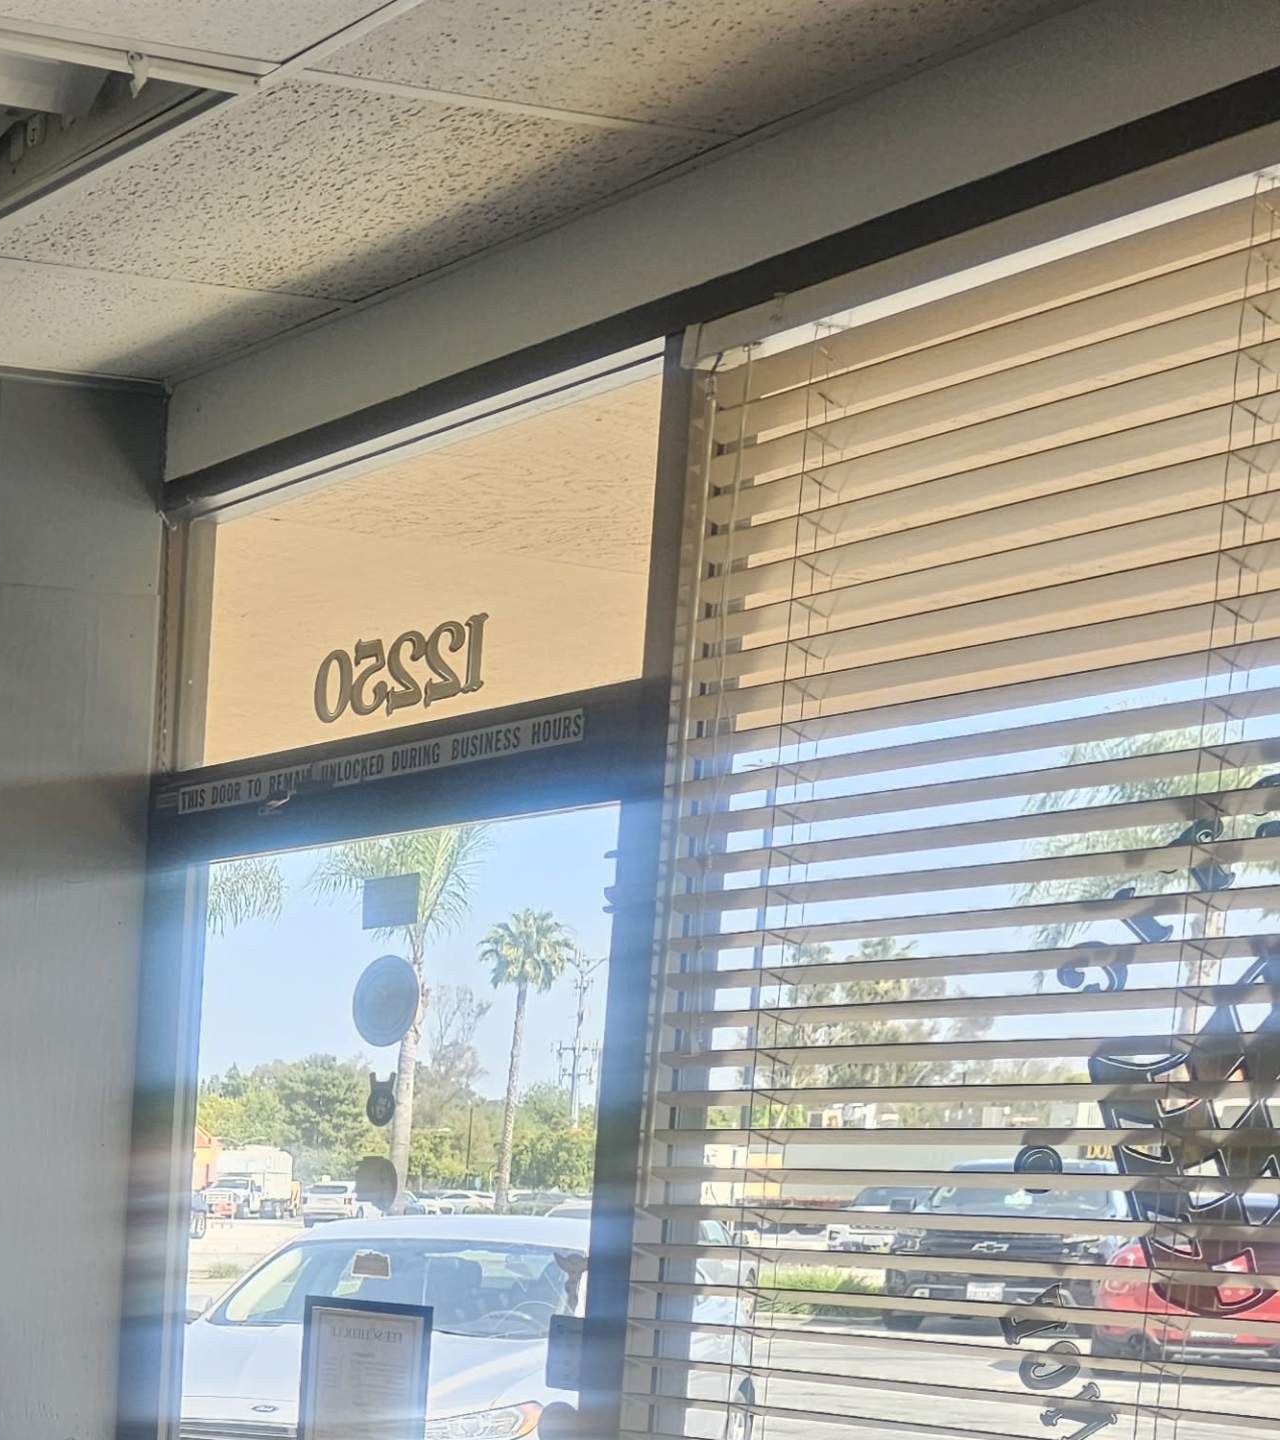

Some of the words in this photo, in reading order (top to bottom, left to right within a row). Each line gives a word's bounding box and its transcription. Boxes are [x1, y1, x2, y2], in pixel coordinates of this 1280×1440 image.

[180, 788, 206, 810] THIS
[212, 784, 241, 806] DOOR
[247, 780, 262, 798] TO
[321, 754, 384, 785] UNLOCKED
[391, 745, 440, 771] DURING
[451, 728, 521, 760] BUSINESS
[531, 715, 582, 745] HOURS
